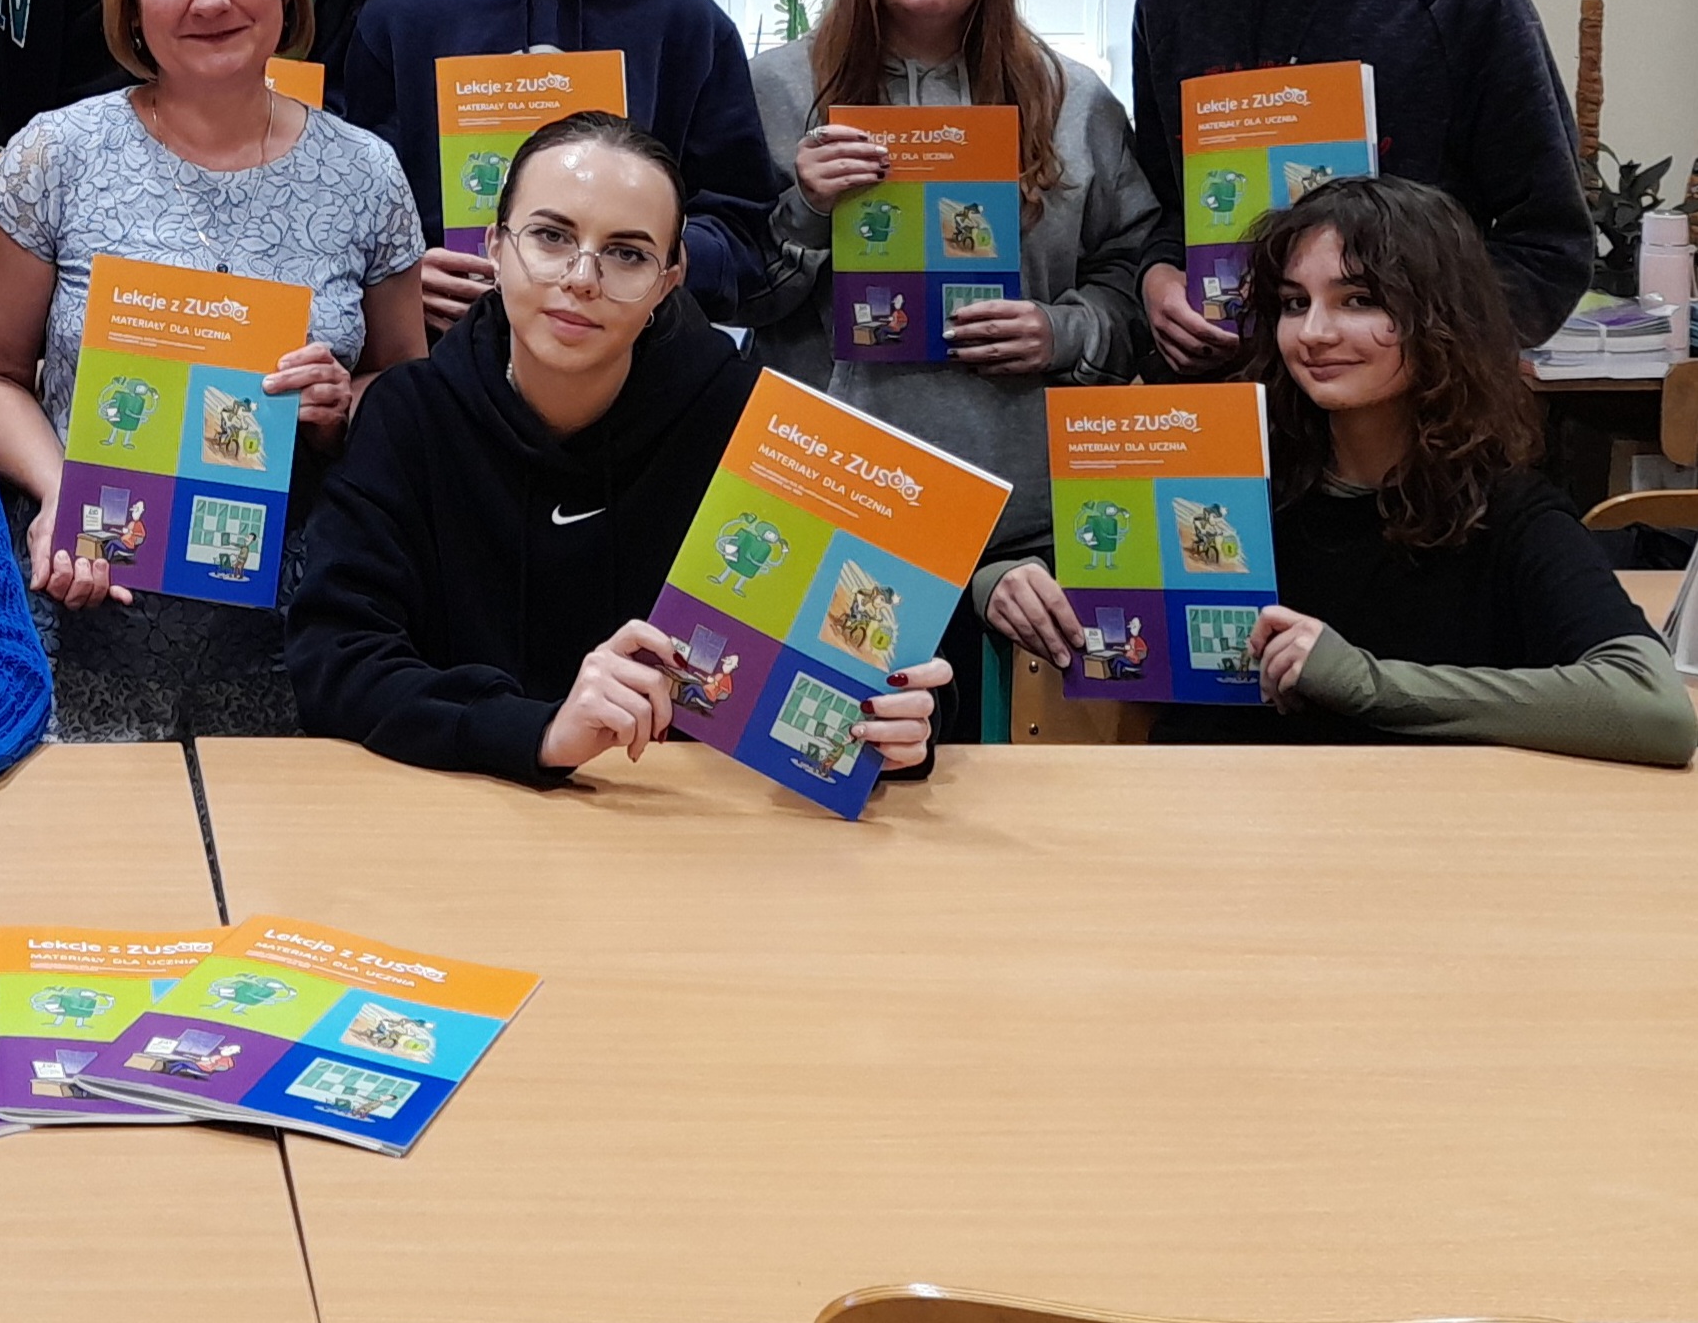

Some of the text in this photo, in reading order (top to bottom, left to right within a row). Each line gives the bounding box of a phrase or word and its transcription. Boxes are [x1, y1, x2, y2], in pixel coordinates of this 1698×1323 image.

[456, 80, 501, 96] Lekcje
[505, 83, 512, 92] z
[1197, 97, 1237, 114] Lekcje
[1241, 99, 1249, 109] z
[867, 130, 895, 145] kcje
[900, 134, 907, 143] z
[113, 287, 167, 310] Lekcje
[171, 300, 179, 310] z
[170, 324, 189, 335] DLA
[194, 328, 231, 341] UCZNIA
[1066, 416, 1116, 434] Lekcje
[1121, 419, 1129, 431] z
[768, 414, 828, 457] Lekcje
[829, 450, 843, 465] z
[1125, 443, 1144, 451] DLA
[1149, 442, 1187, 451] UCZNIA
[758, 443, 820, 481] MATERIAŁY
[822, 477, 846, 496] DLA
[850, 492, 893, 518] UCZNIA
[28, 939, 101, 952] Lekcje
[264, 929, 335, 952] Lekcje
[339, 949, 353, 958] z
